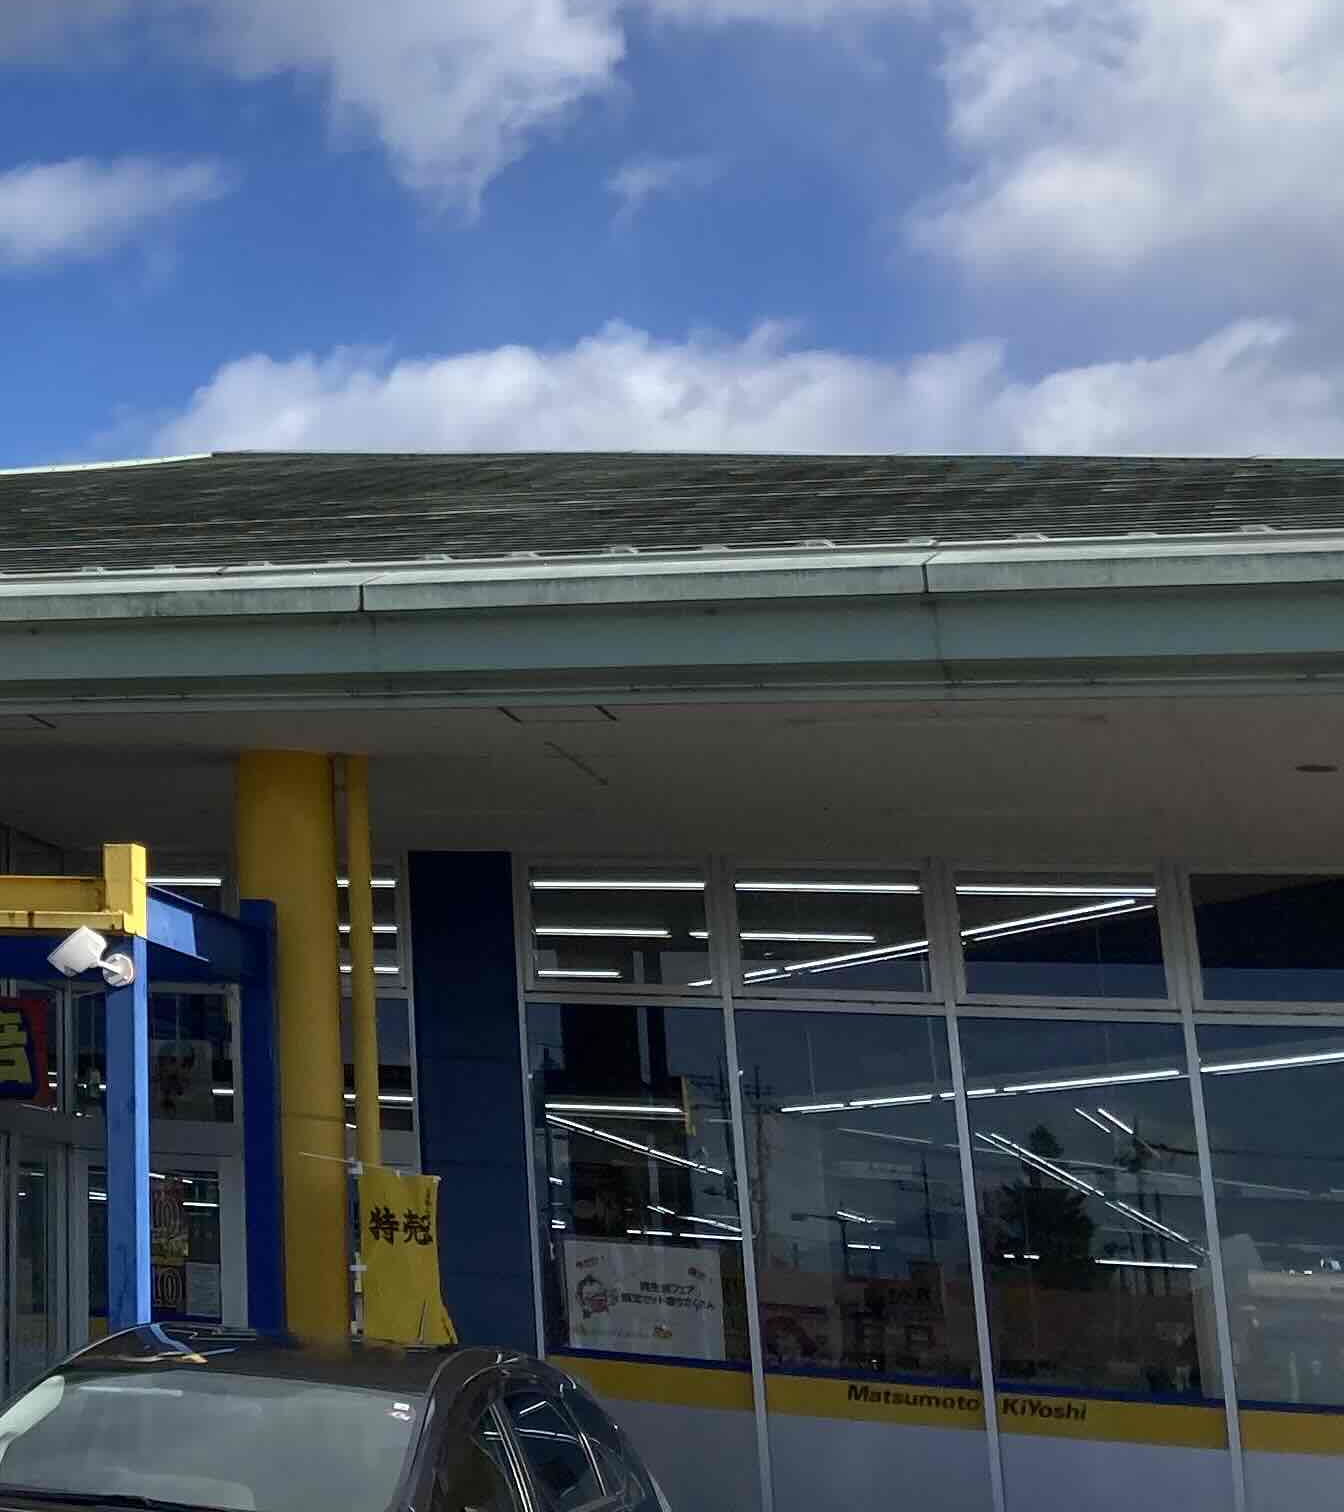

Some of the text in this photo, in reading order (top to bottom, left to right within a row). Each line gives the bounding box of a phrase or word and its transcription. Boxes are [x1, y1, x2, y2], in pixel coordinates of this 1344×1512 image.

[368, 1204, 434, 1246] 特売
[847, 1384, 1088, 1421] Matsumoto KiYoshi
